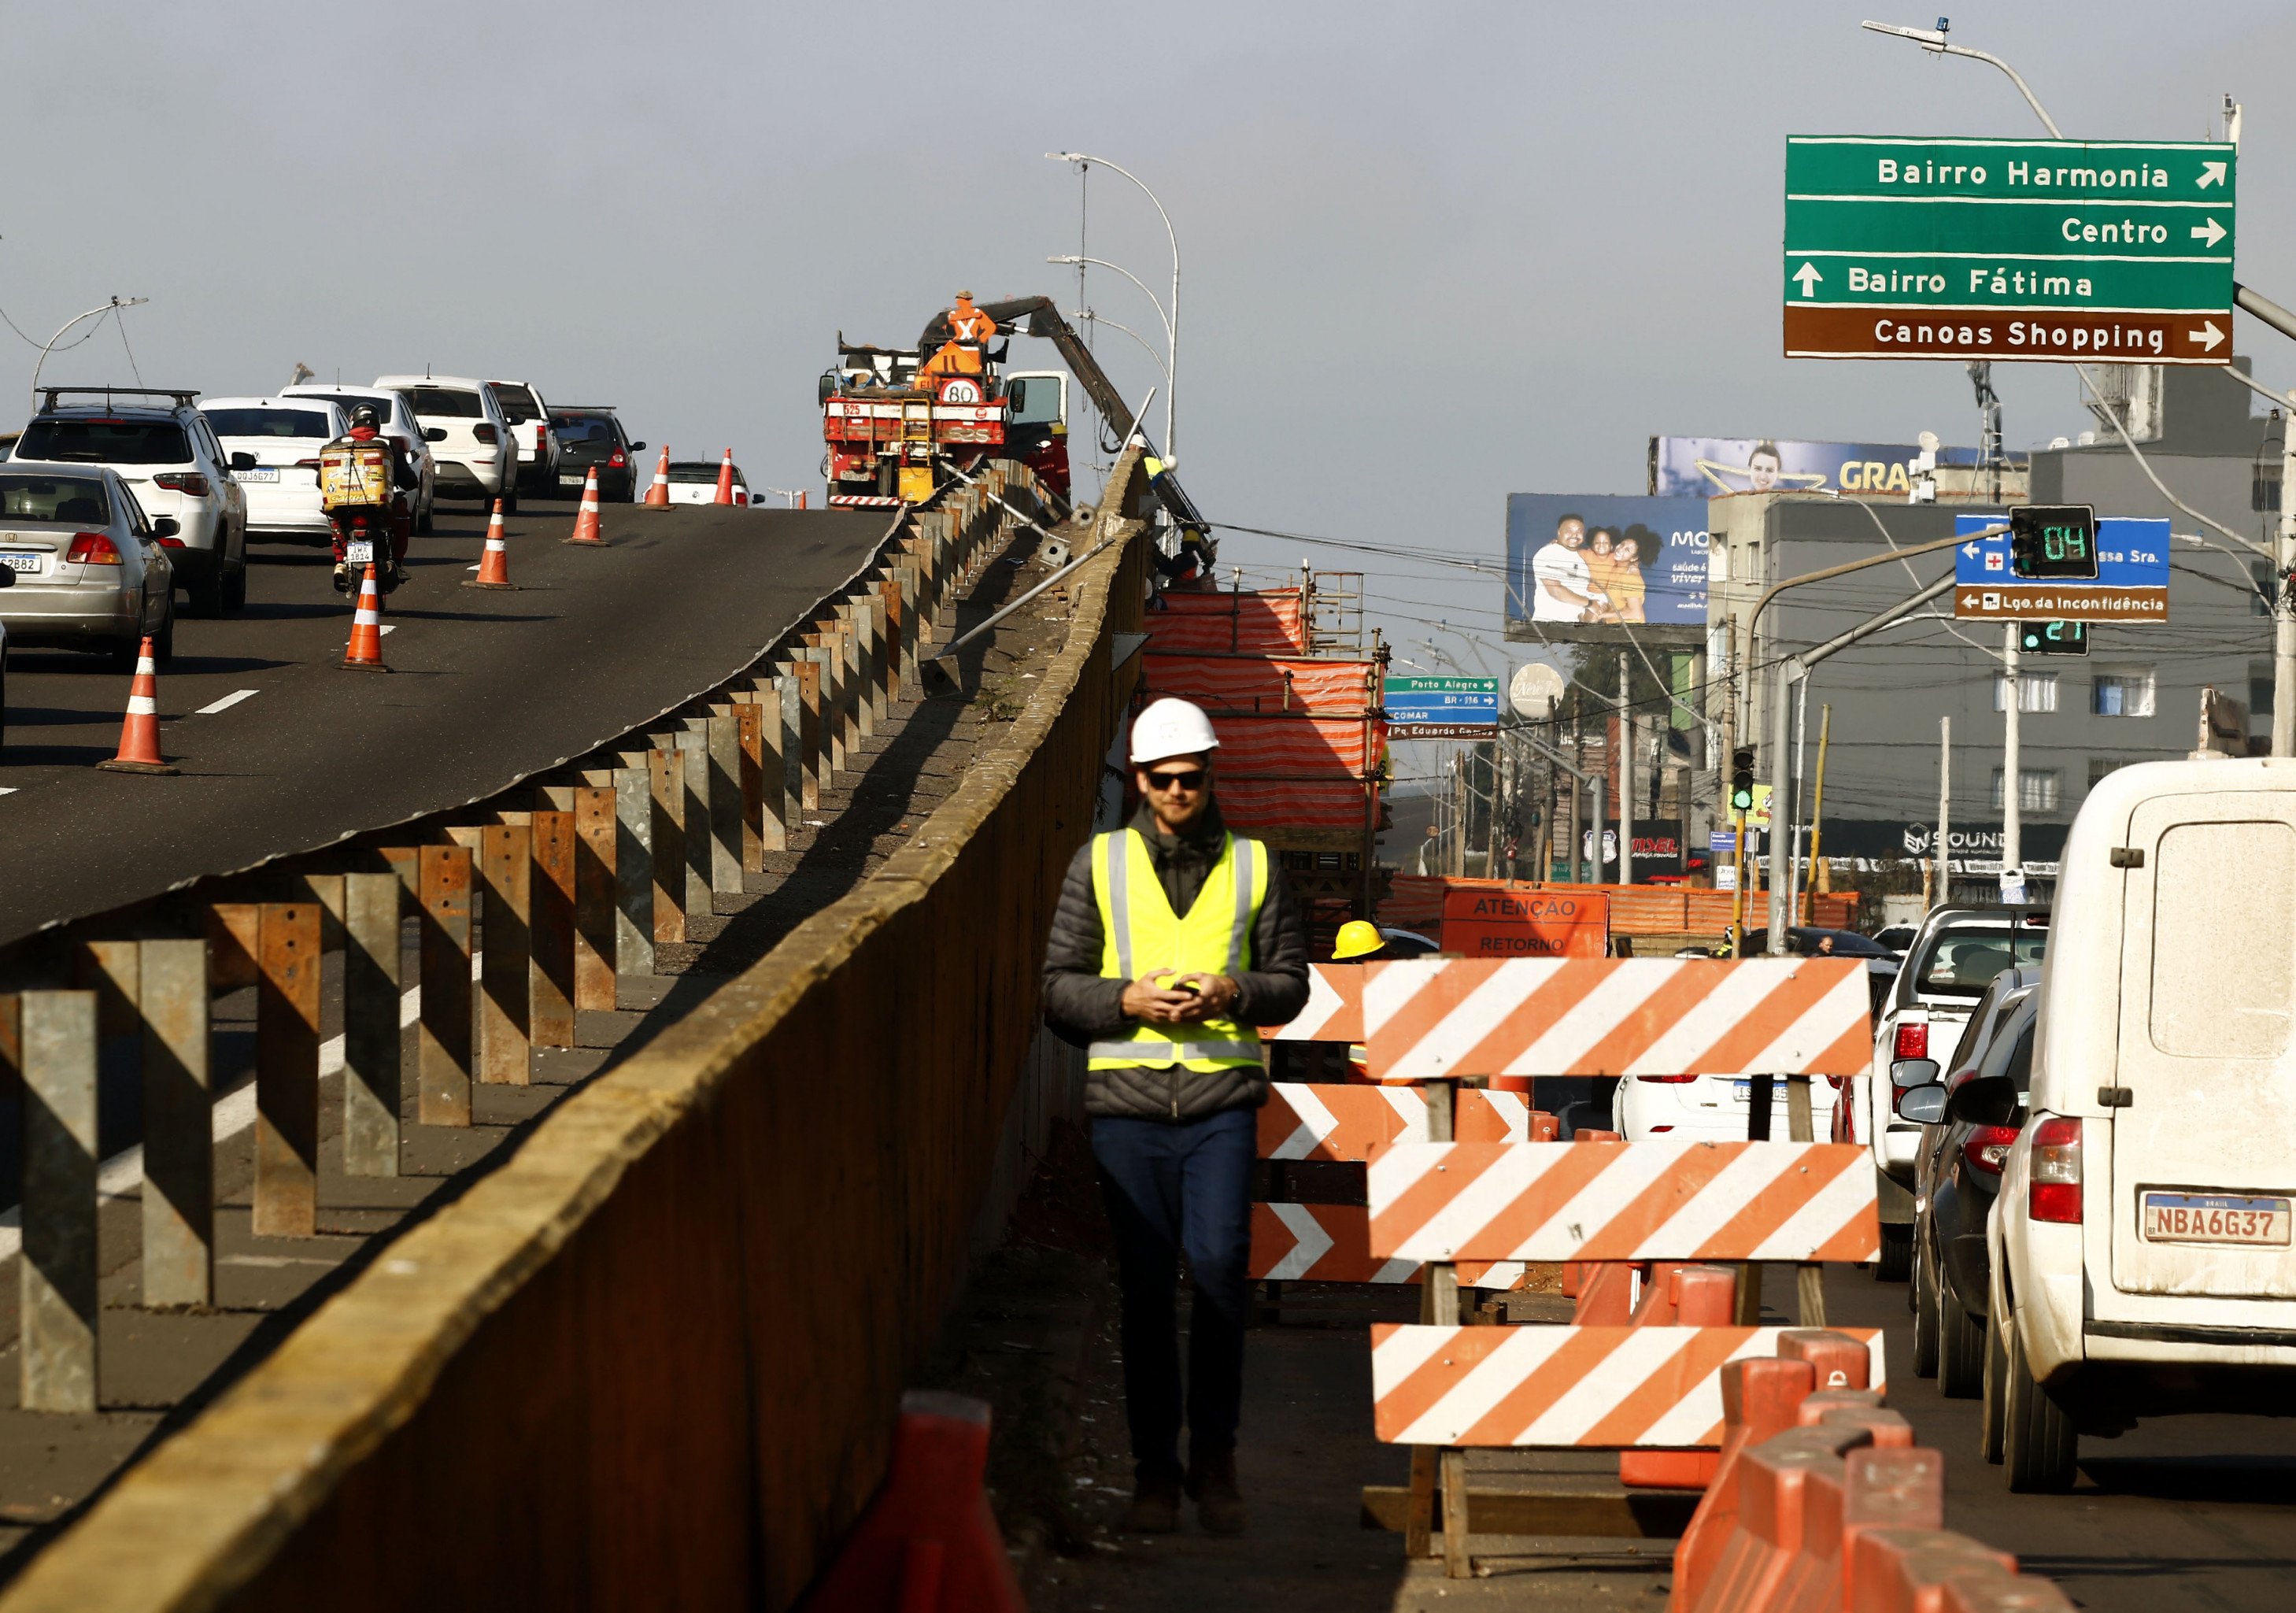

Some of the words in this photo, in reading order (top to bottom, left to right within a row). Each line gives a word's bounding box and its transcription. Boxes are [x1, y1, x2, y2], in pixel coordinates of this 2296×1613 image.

[1878, 159, 1987, 184] Bairro
[2008, 161, 2168, 188] Harmonia
[2061, 218, 2168, 244] Centro
[1848, 268, 1946, 294] Bairro
[1970, 268, 2092, 296] Fátima
[1875, 320, 1993, 346] Canoas
[2008, 321, 2163, 353] Shopping
[949, 387, 973, 403] 80
[844, 405, 860, 415] 525
[2043, 526, 2086, 560] 04
[2130, 549, 2159, 563] Sra.
[2057, 596, 2164, 611] Inconfidência
[1411, 680, 1439, 689] Porto
[1444, 680, 1478, 690] Alegre
[1395, 727, 1409, 736] Pq.
[1412, 727, 1455, 735] Eduardo
[1473, 897, 1577, 919] ATENÇÃO
[1481, 937, 1564, 951] RETORNO
[2157, 1208, 2274, 1237] NBA6G37
